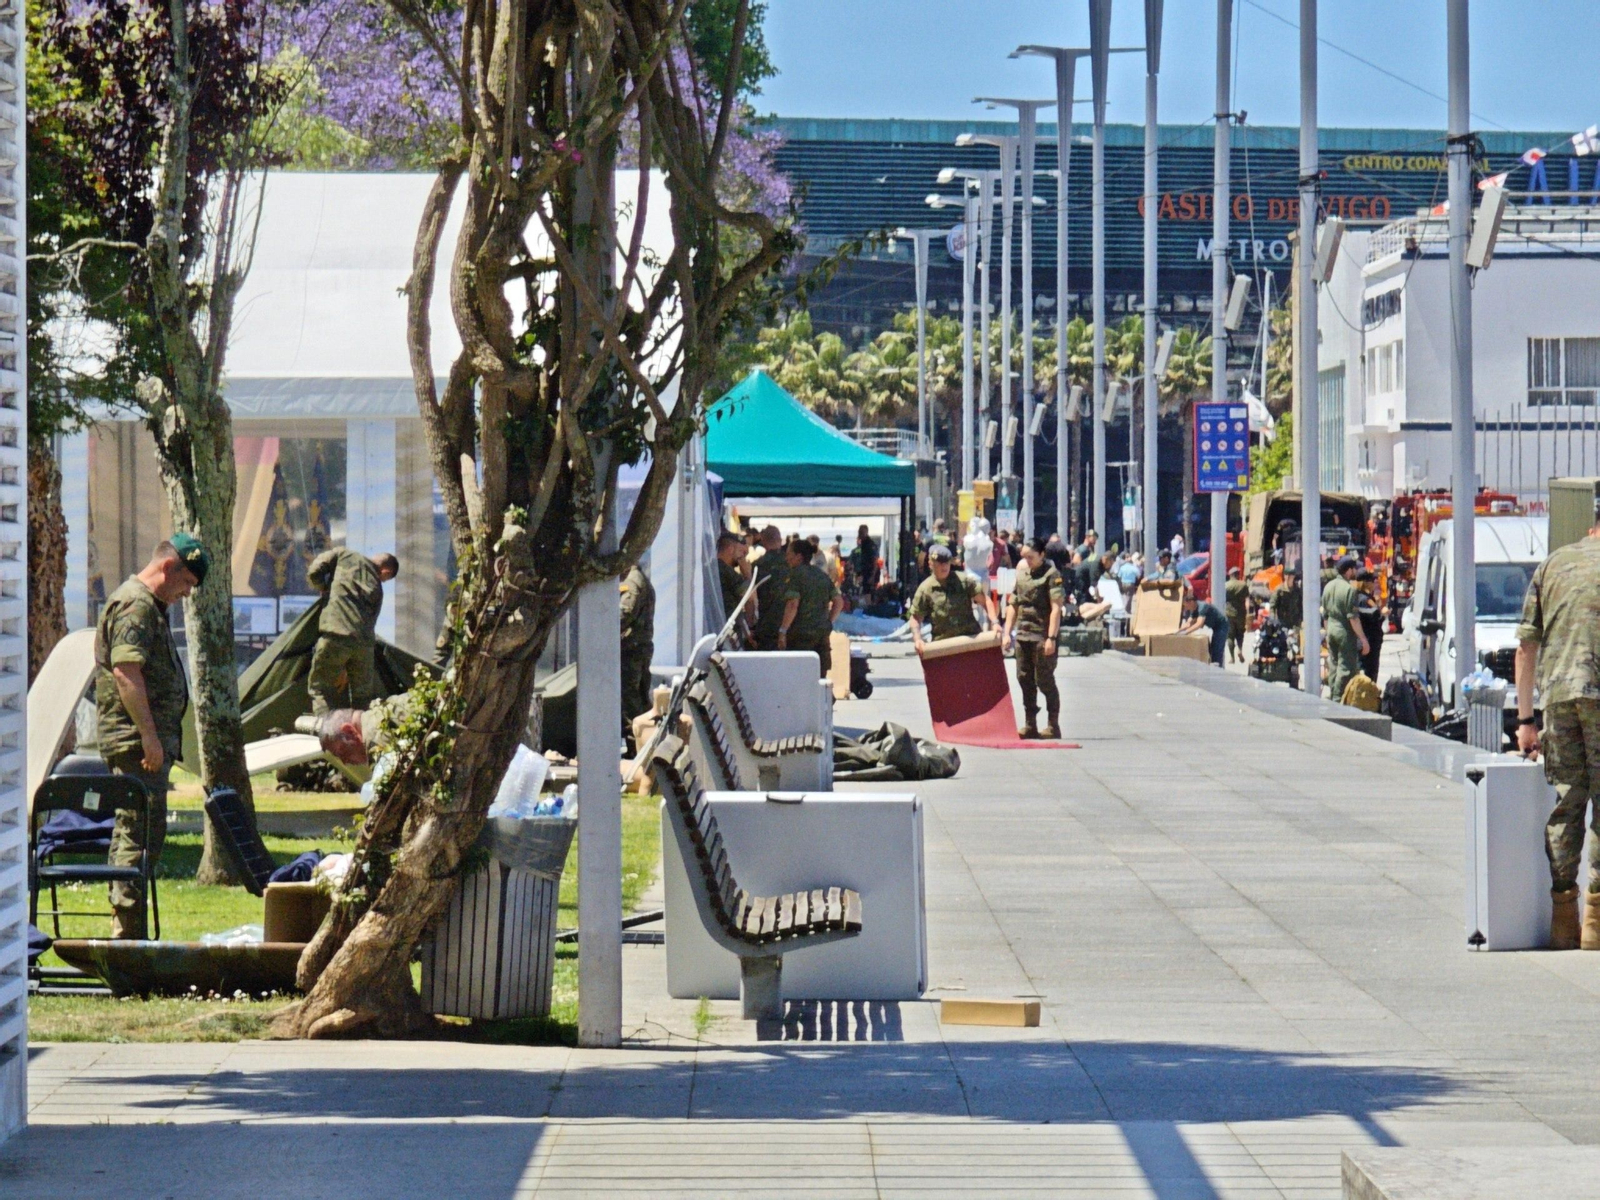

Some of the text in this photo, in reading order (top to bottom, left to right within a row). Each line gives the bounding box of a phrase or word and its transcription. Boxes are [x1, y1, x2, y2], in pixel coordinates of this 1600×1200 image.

[1343, 155, 1403, 171] CENTRO
[1137, 192, 1255, 221] ASIO
[1196, 237, 1289, 261] MTRO
